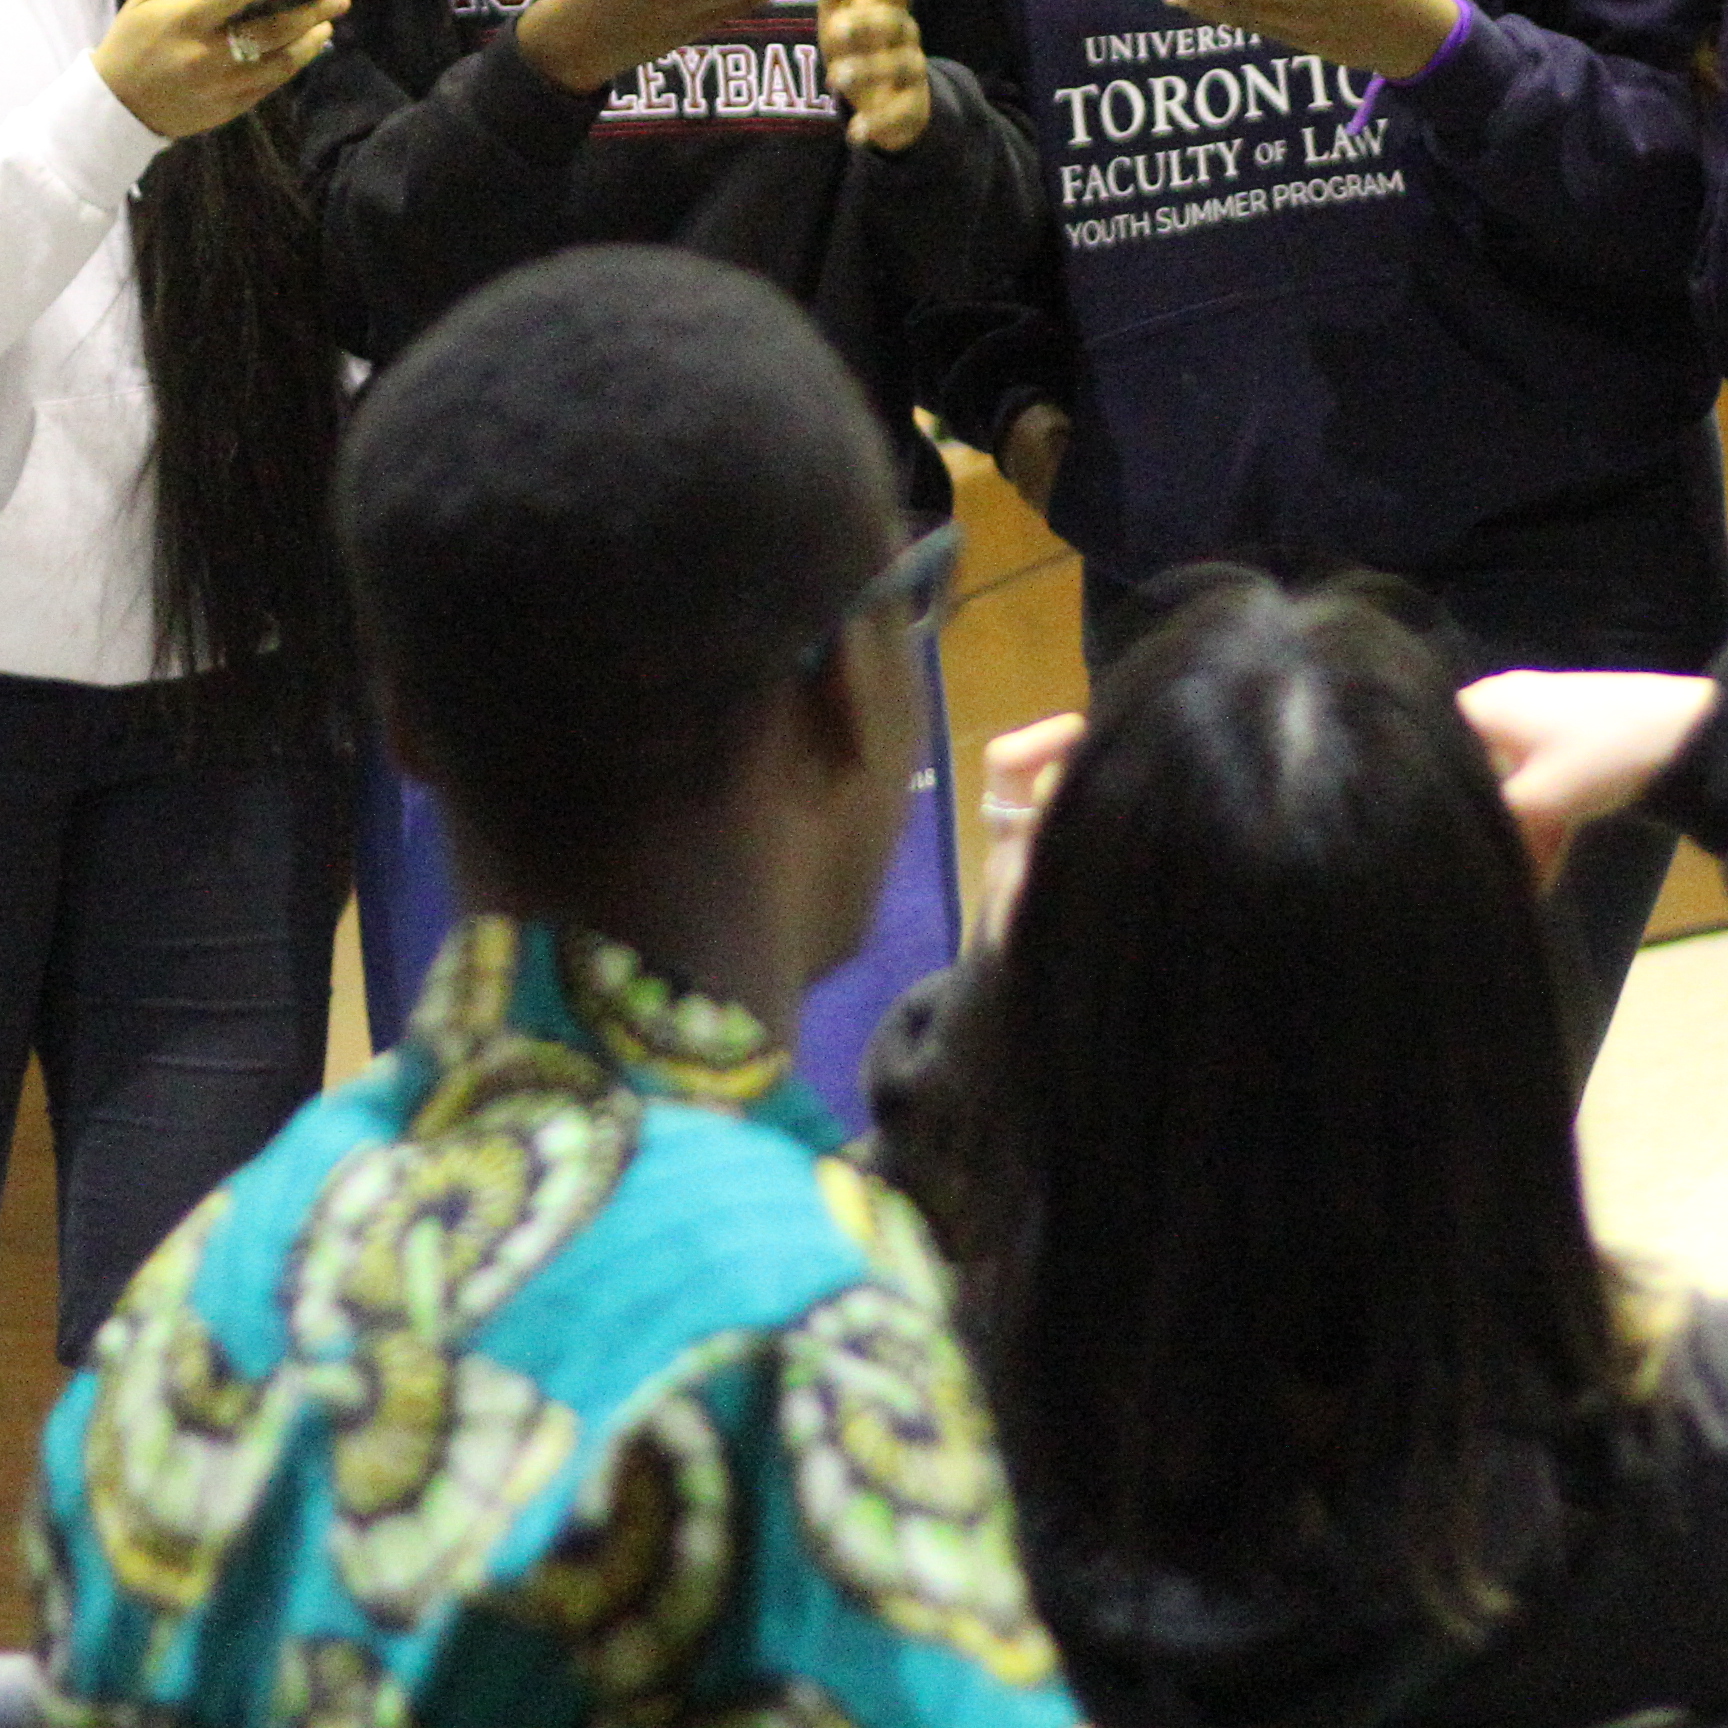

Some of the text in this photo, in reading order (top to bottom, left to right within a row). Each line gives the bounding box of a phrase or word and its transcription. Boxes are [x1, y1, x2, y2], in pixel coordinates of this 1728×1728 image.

[1084, 23, 1262, 65] UNIVERSI
[1060, 118, 1389, 205] FACULTY OF LAW
[1065, 169, 1406, 249] YOUTH SUMMER PROGRAM
